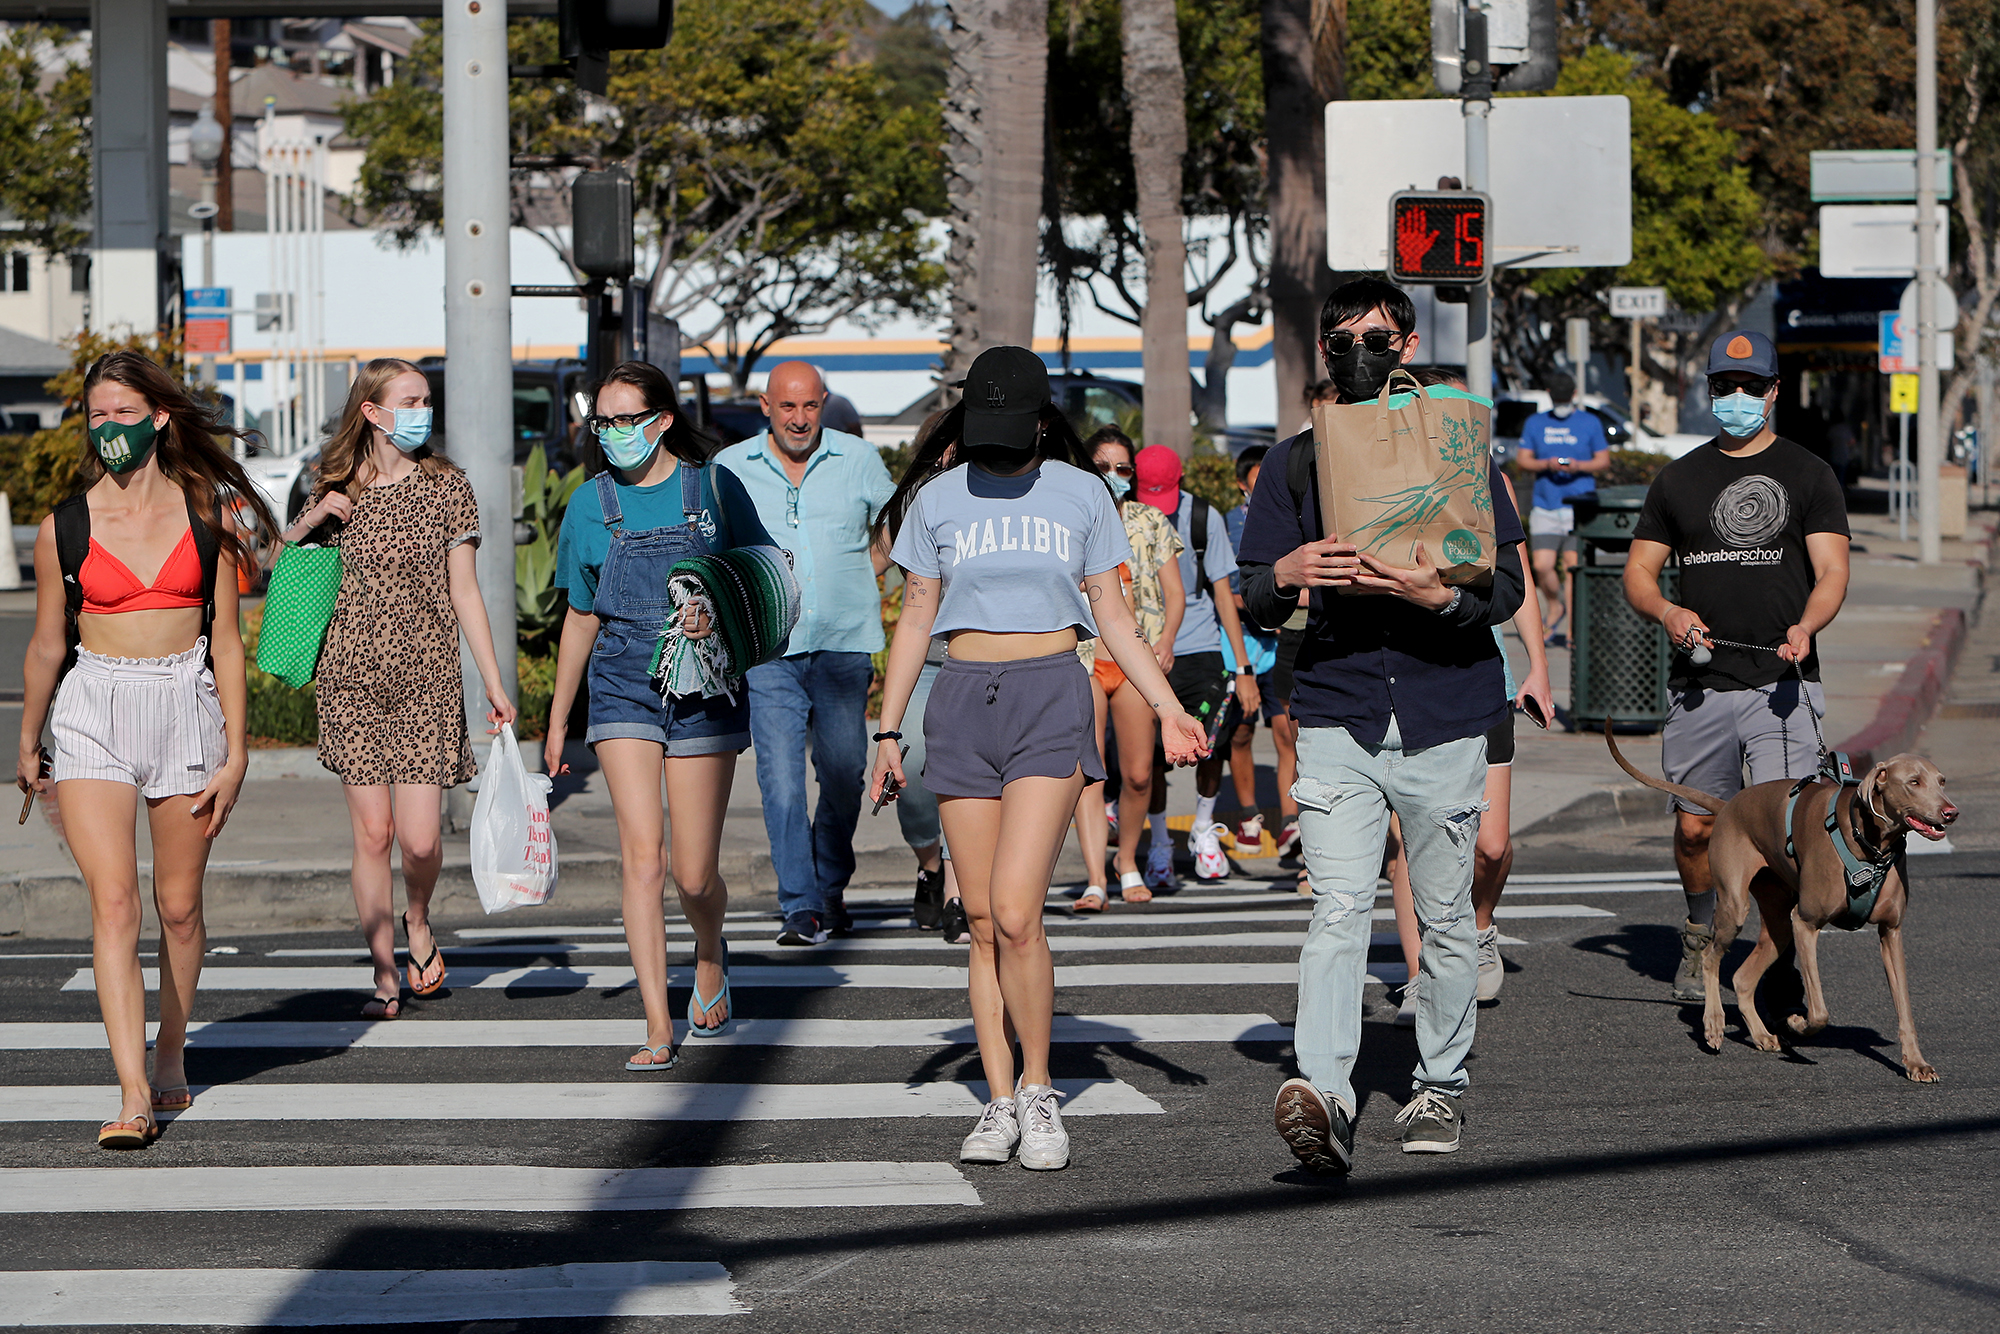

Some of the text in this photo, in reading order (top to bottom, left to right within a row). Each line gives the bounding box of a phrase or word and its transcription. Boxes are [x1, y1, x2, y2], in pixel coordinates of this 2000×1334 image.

[1454, 212, 1483, 267] 15
[1616, 294, 1658, 309] EXIT
[986, 381, 1006, 407] LA
[100, 433, 131, 460] CUI
[952, 515, 1070, 568] MALIBU
[1445, 539, 1478, 548] WHOLE
[1448, 547, 1478, 556] FOODS
[1682, 547, 1784, 566] shebraberschool
[526, 803, 550, 823] Tan
[526, 824, 551, 844] Tan
[523, 845, 551, 864] Tan
